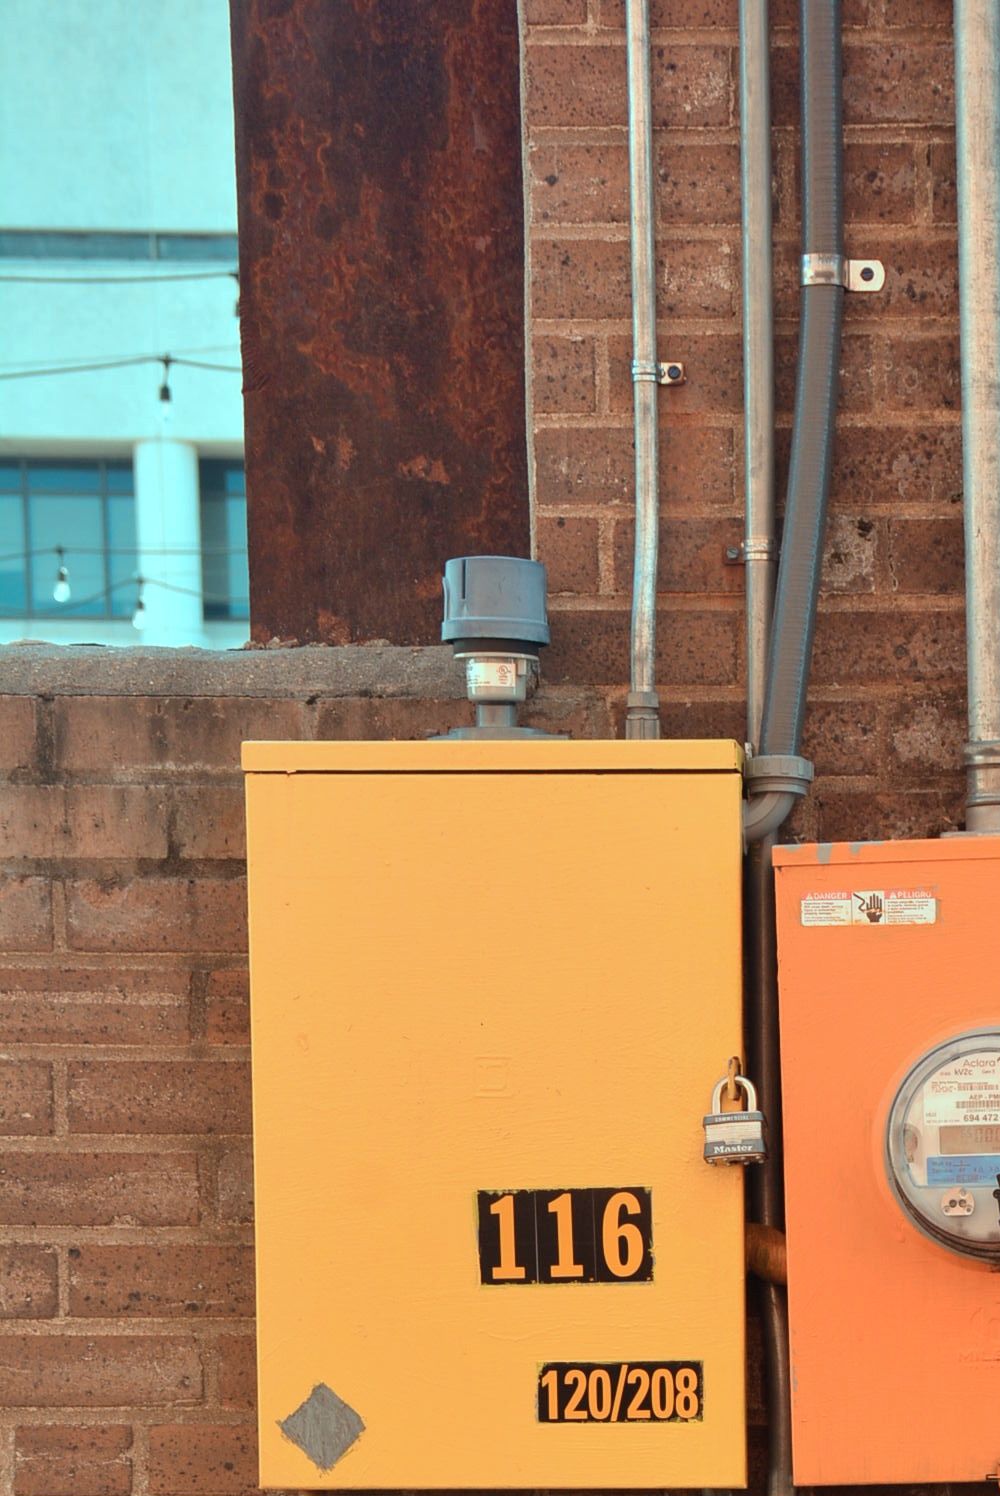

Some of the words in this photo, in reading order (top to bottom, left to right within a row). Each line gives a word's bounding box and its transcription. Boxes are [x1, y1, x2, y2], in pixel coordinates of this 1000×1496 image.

[813, 892, 847, 900] DANGER
[963, 1059, 996, 1067] Aclara
[963, 1114, 980, 1122] 694
[982, 1113, 999, 1121] 472
[713, 1145, 753, 1154] Master
[489, 1191, 645, 1280] 116
[541, 1364, 699, 1422] 120/208
